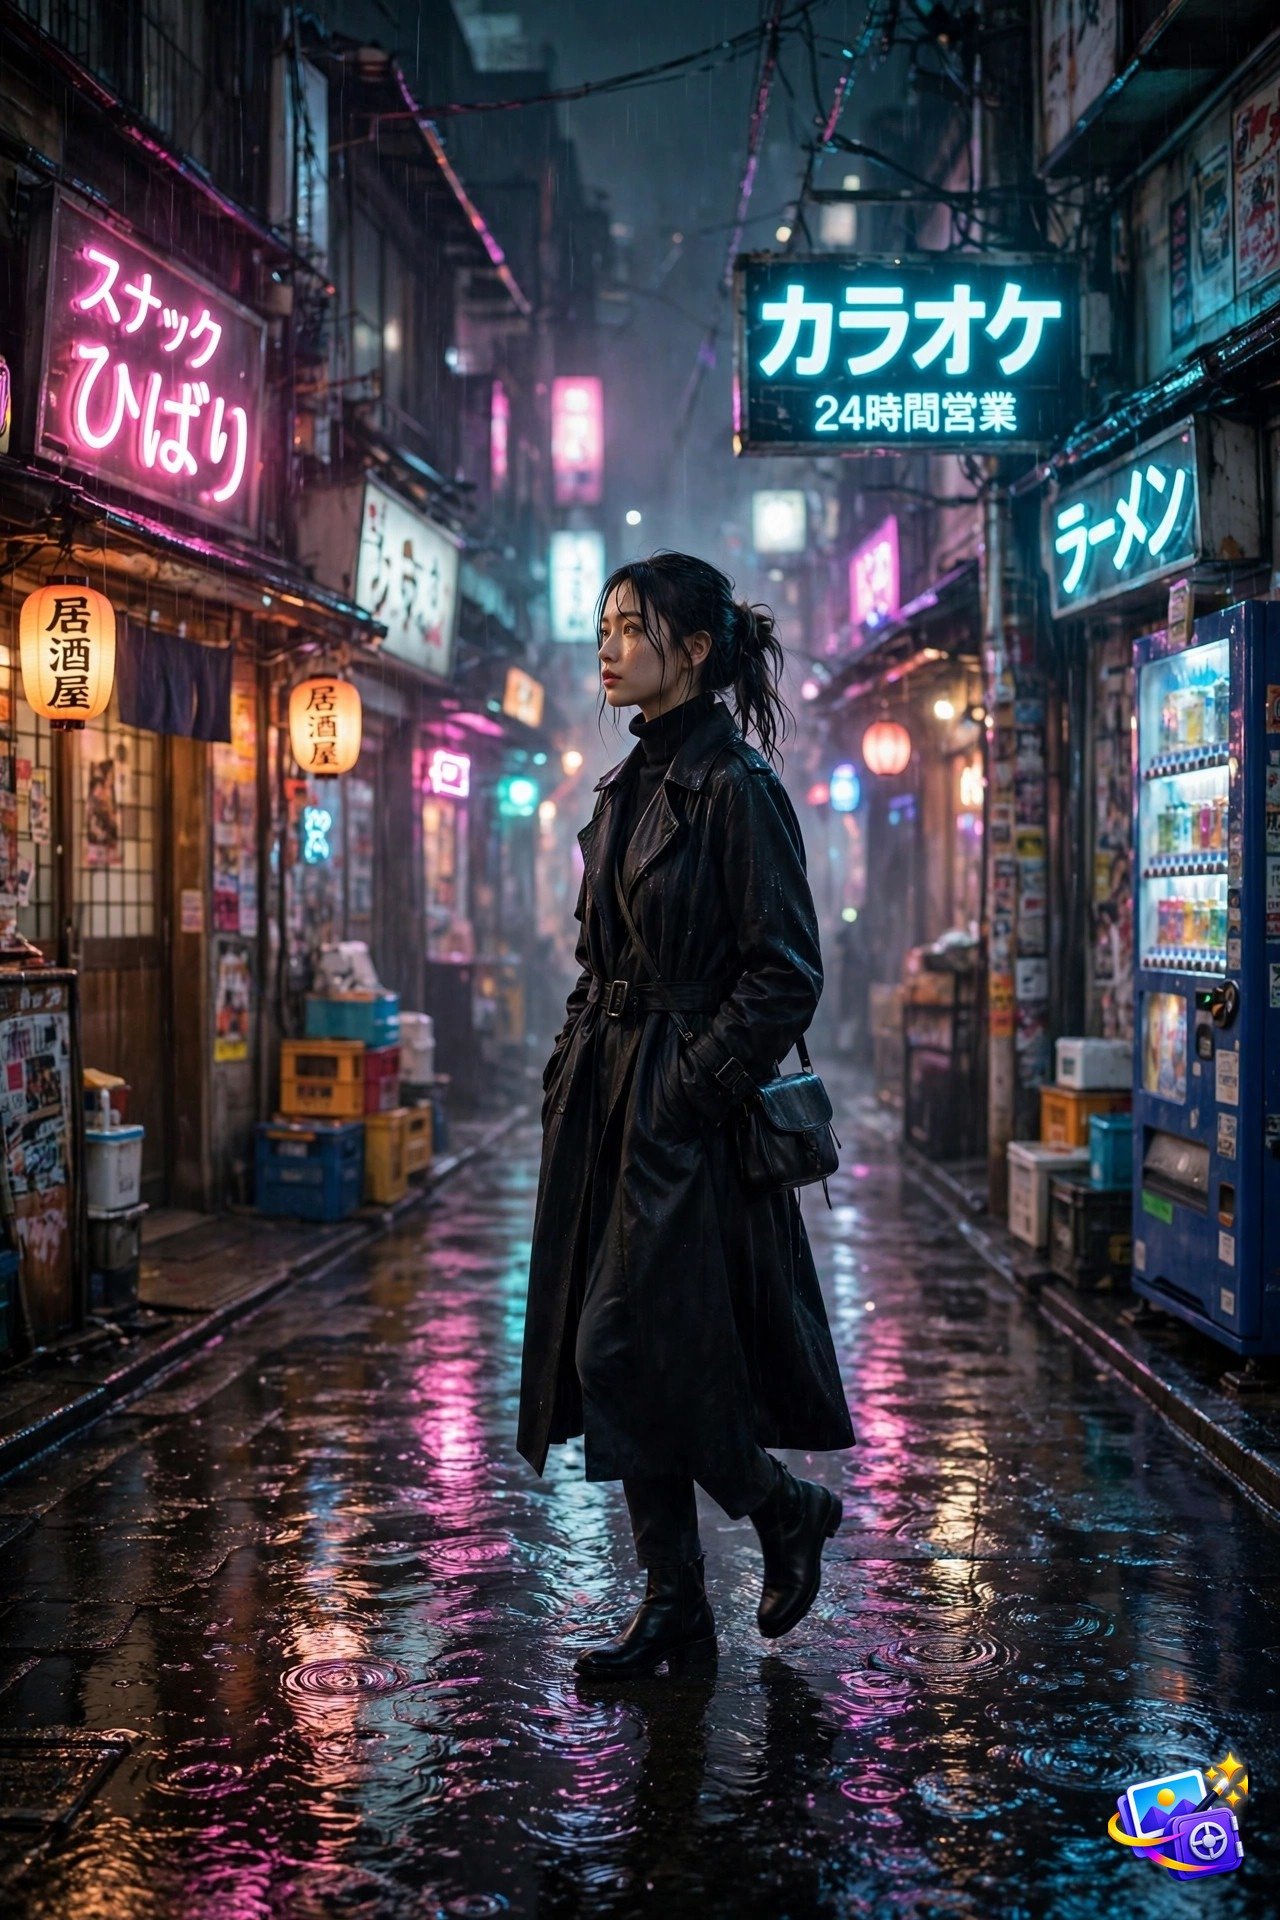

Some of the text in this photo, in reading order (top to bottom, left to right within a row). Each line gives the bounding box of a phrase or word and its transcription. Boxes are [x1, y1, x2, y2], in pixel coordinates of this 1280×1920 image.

[78, 248, 222, 368] スナック
[758, 283, 1062, 377] カラオケ
[76, 344, 248, 502] ひばり
[814, 391, 1018, 433] 24時間営業
[1055, 464, 1186, 594] ラーメン
[46, 596, 91, 709] 居酒屋
[306, 685, 338, 765] 居酒屋
